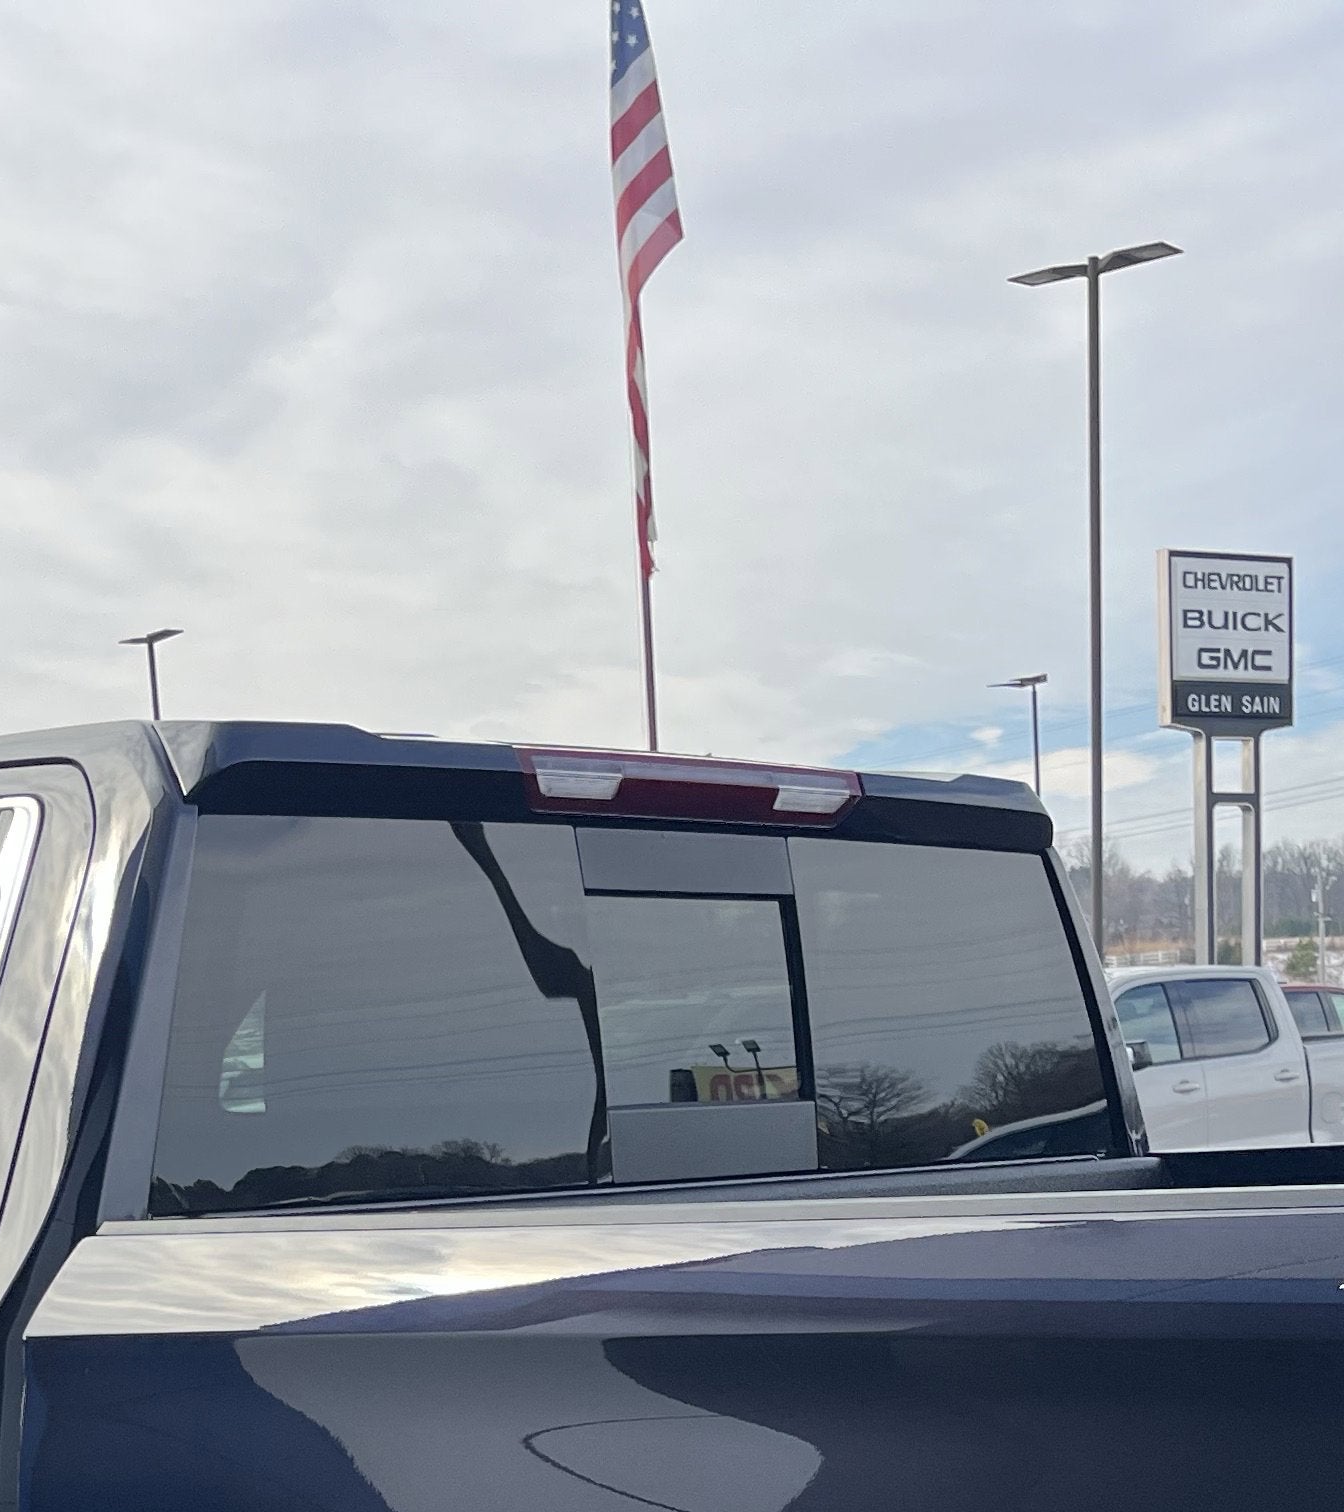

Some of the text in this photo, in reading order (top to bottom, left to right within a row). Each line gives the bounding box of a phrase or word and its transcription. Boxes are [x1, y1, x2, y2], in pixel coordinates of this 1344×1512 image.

[1182, 571, 1284, 593] CHEVROLET
[1182, 609, 1285, 633] BUICK
[1197, 647, 1272, 671] GMC
[1187, 693, 1280, 714] GLEN SAIN
